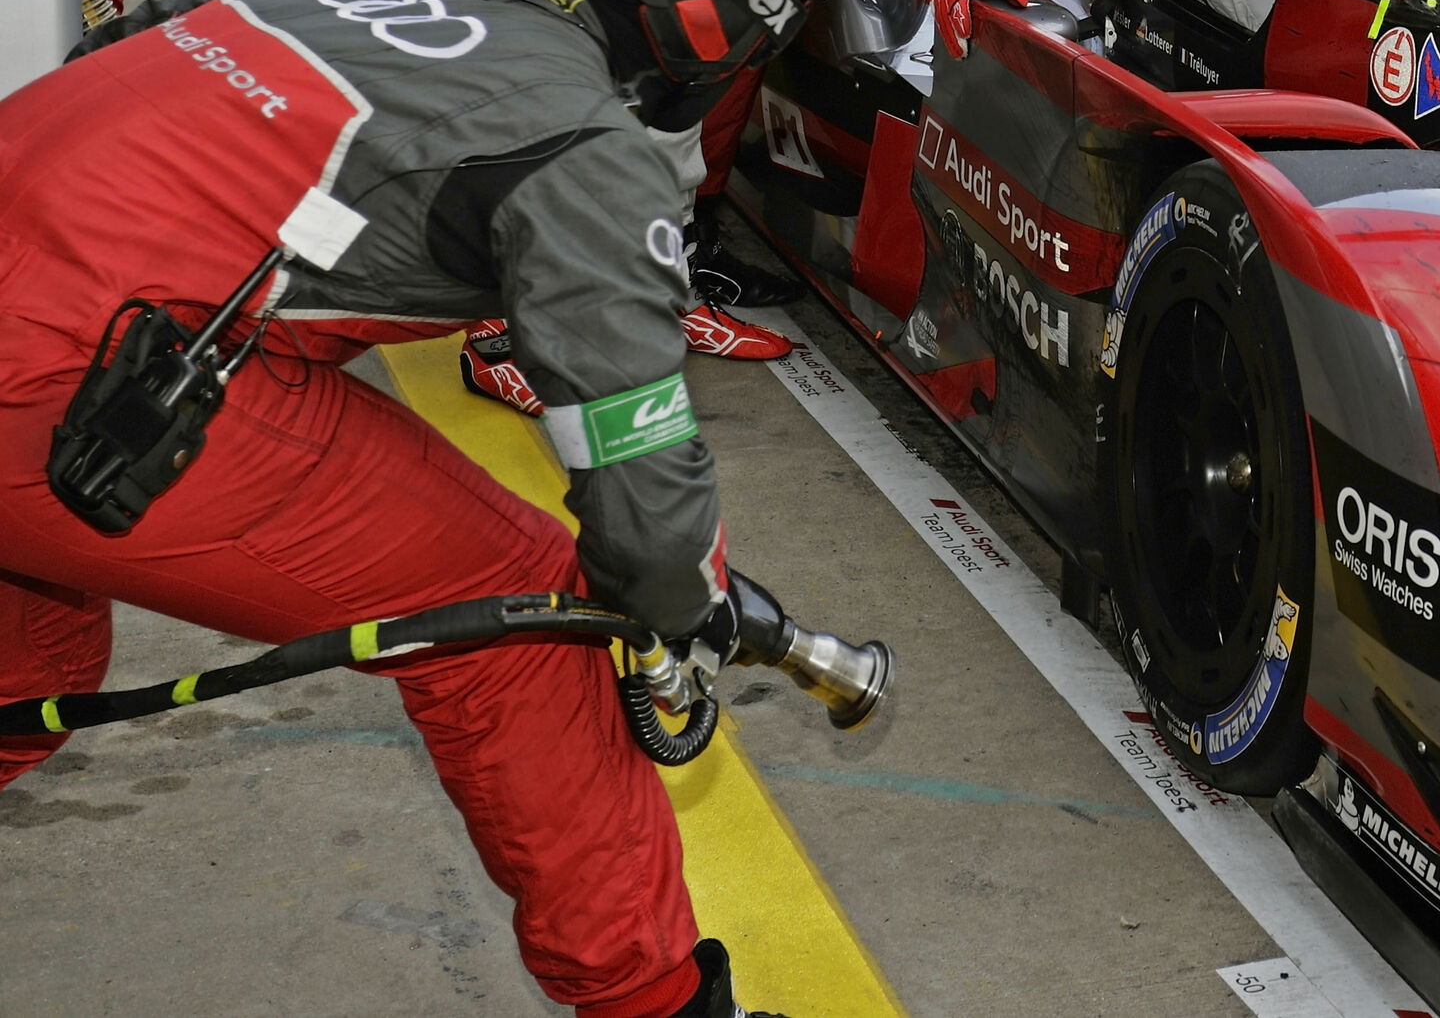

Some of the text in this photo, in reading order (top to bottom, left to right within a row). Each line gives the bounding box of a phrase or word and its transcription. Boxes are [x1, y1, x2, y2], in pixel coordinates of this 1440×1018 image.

[156, 14, 288, 120] Audi Sport
[1144, 25, 1174, 56] Lotterer
[1188, 51, 1220, 86] Tréluyer
[1382, 49, 1403, 94] E
[767, 100, 812, 167] P1
[943, 137, 1071, 273] Audi Sport
[1114, 203, 1171, 304] MICHELIN
[775, 357, 822, 399] eam Joest
[797, 348, 846, 394] Audi Sport
[920, 512, 985, 574] Team Joest
[946, 510, 1013, 569] Audi Sport
[1334, 538, 1434, 621] Swiss Watches
[1208, 666, 1273, 754] MICHELIN
[1114, 729, 1198, 814] Team Joest
[1234, 971, 1266, 995] -50
